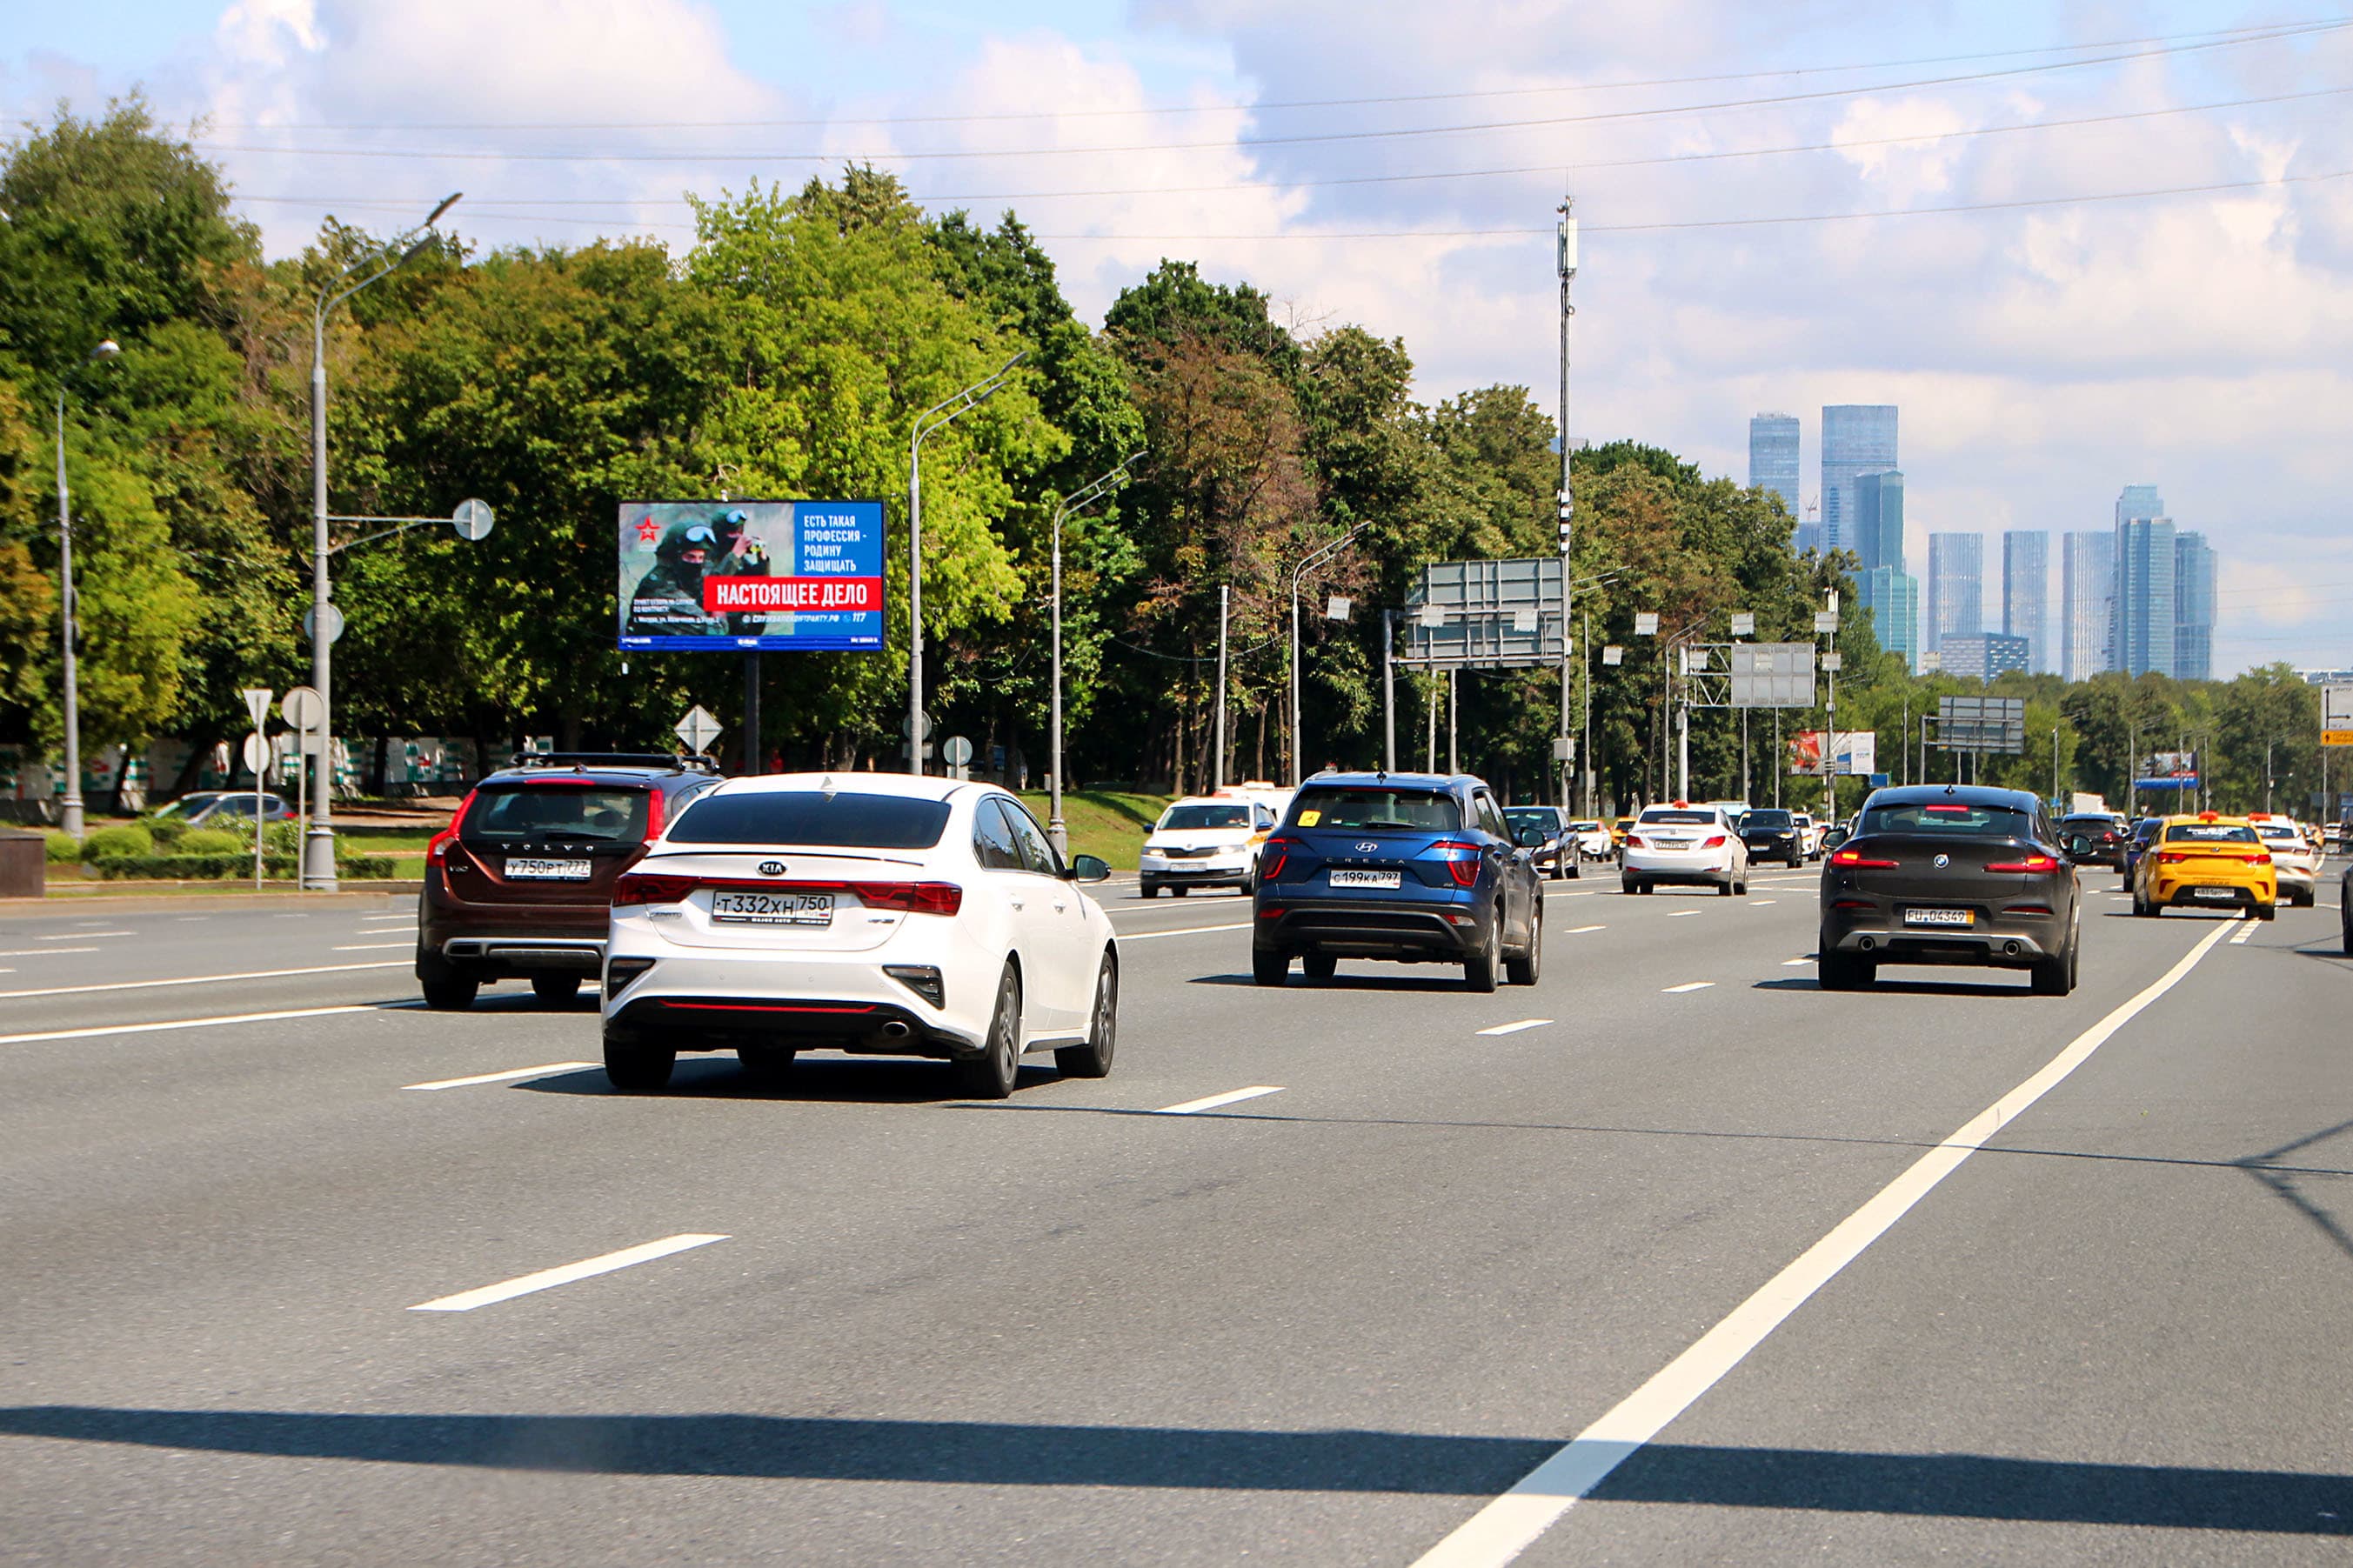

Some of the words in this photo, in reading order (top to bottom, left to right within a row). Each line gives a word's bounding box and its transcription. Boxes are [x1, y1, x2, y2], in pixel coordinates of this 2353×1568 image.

[804, 515, 826, 527] ЕСТЬ
[828, 515, 856, 527] ТАКАЯ
[804, 530, 860, 542] ПРОФЕССИЯ
[804, 544, 842, 557] РОДИНУ
[804, 559, 856, 572] ЗАЩИЩАТЬ
[717, 584, 819, 607] НАСТОЯЩЕЕ
[821, 584, 867, 607] ДЕЛО
[852, 612, 866, 623] 117
[762, 864, 783, 873] KIA
[721, 895, 794, 915] Т332ХН
[799, 897, 827, 911] 750
